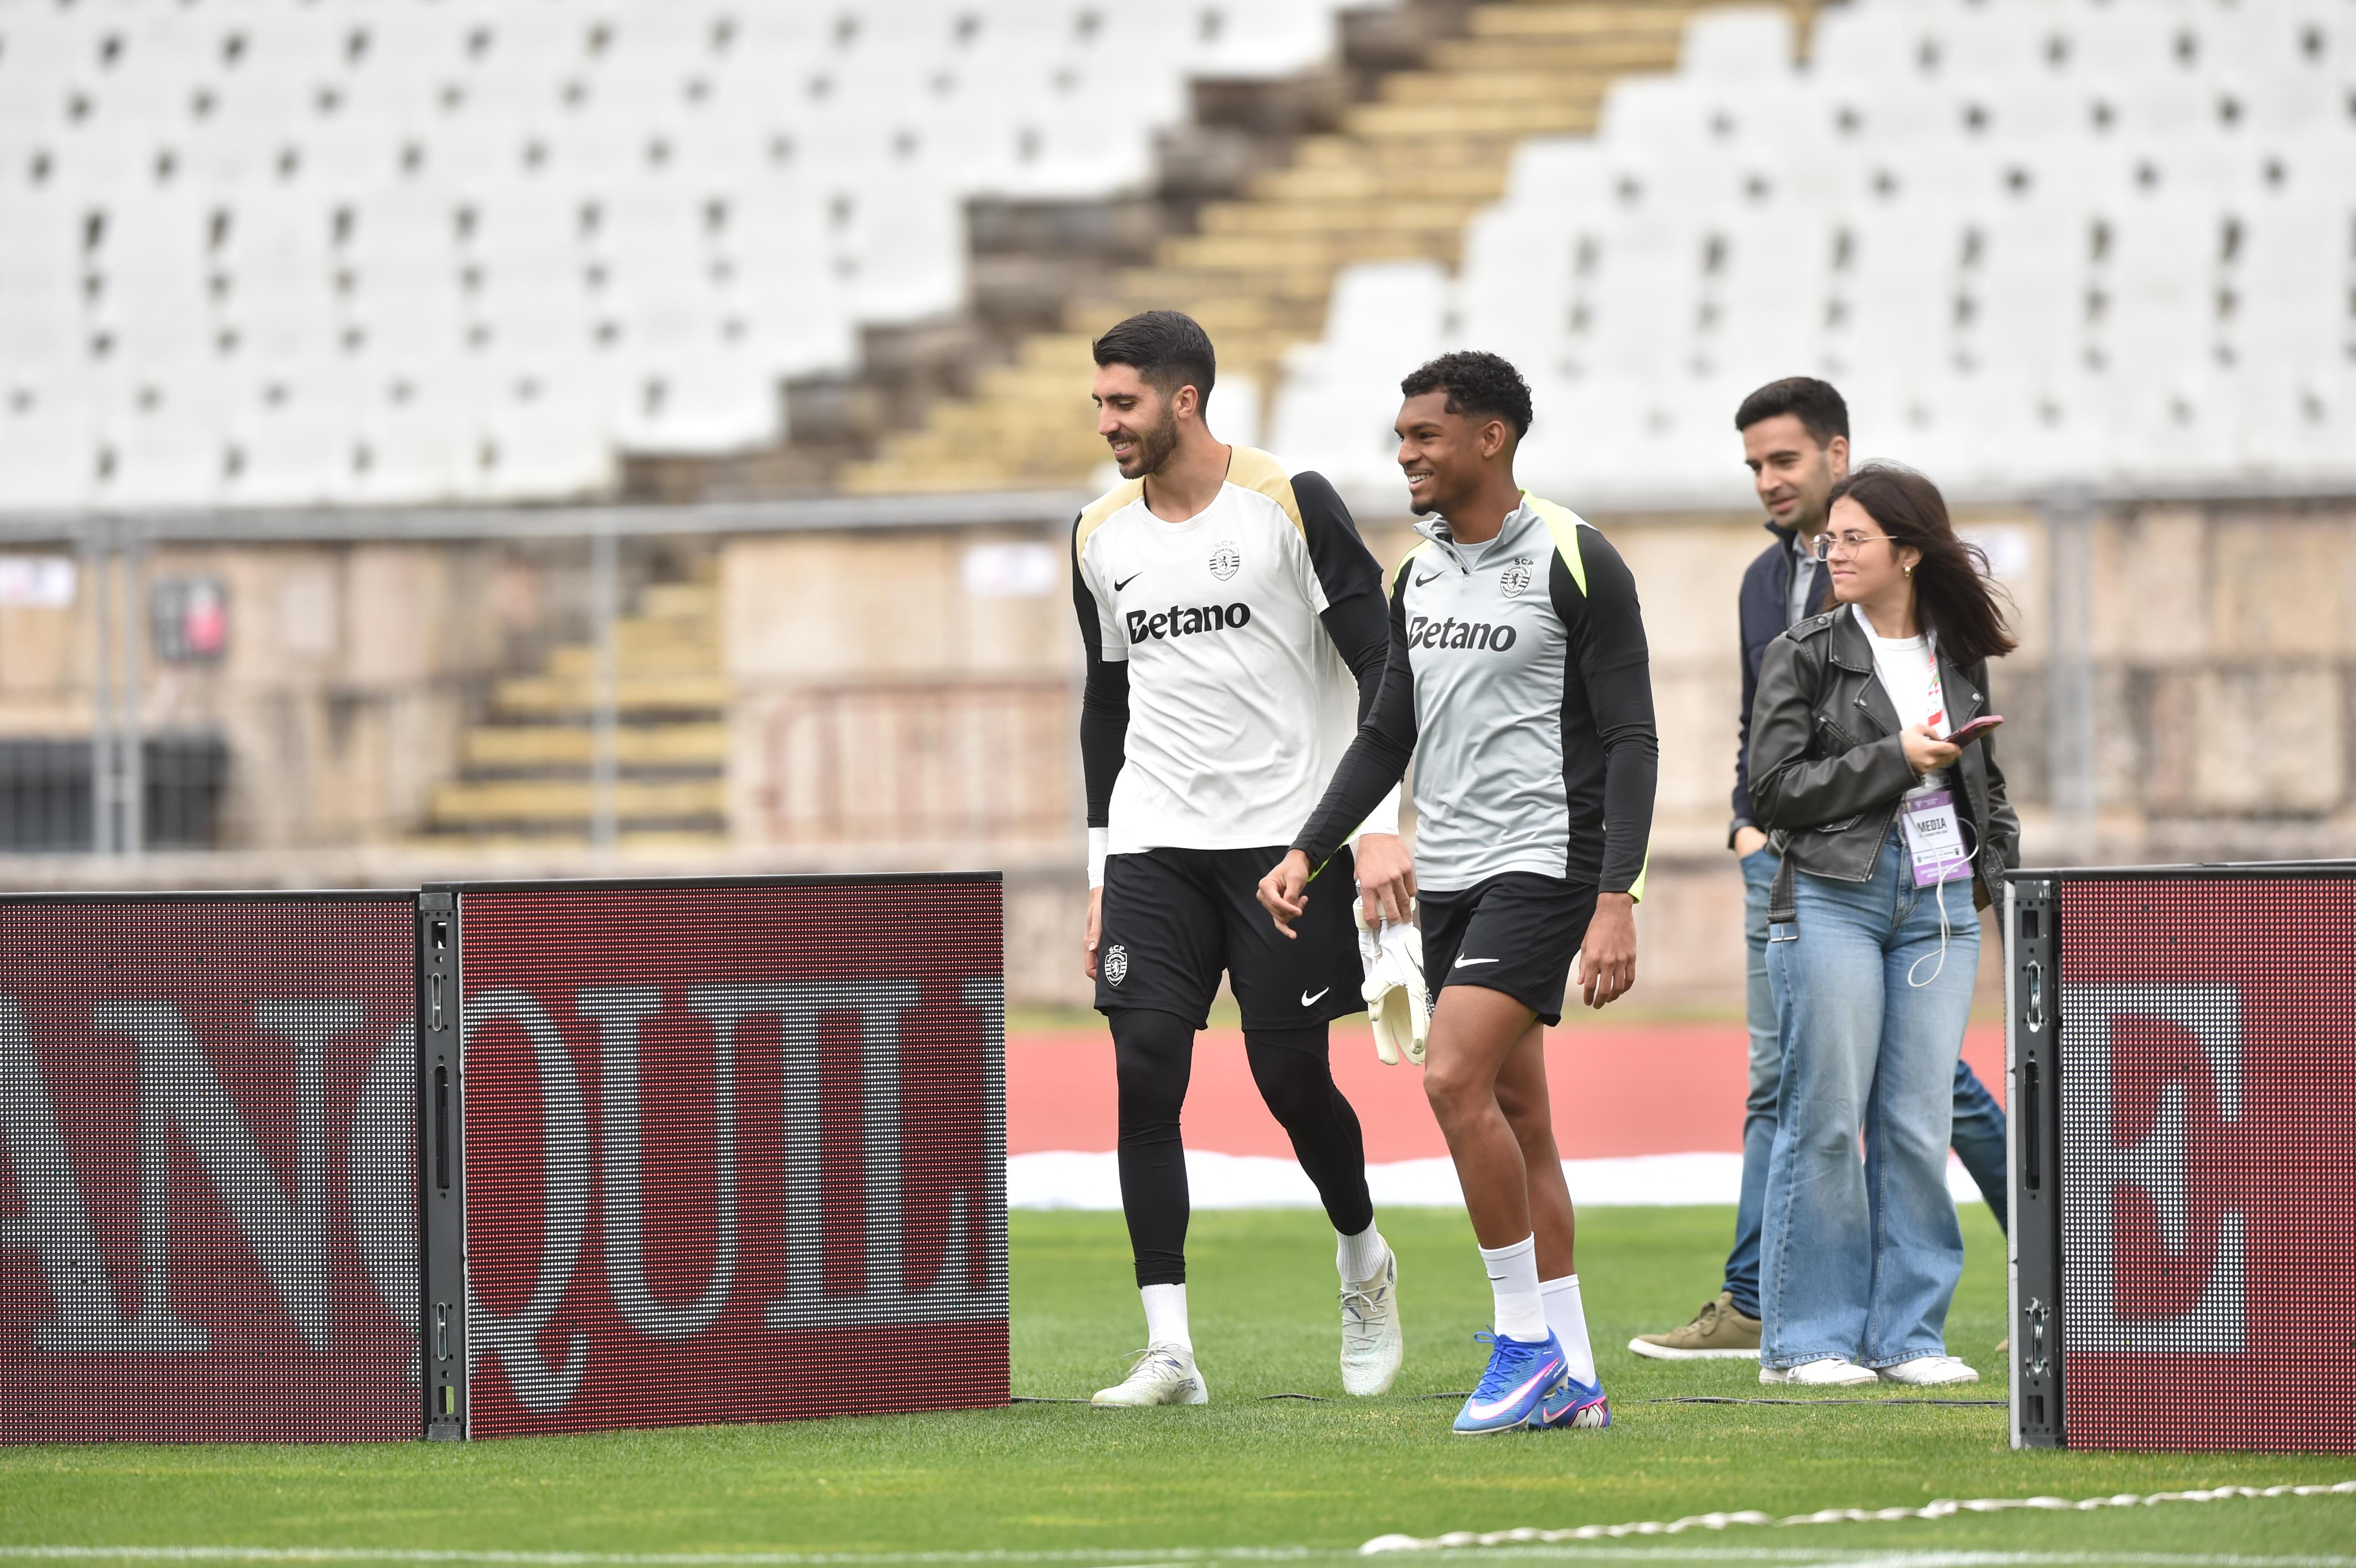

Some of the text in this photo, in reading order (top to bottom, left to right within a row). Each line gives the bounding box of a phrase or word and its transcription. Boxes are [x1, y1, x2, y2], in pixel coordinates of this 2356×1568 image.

[1126, 602, 1251, 645] Betano
[1408, 616, 1516, 652] Betano
[1917, 817, 1947, 832] MEDIA
[1109, 945, 1125, 954] SCP
[2062, 982, 2246, 1353] E
